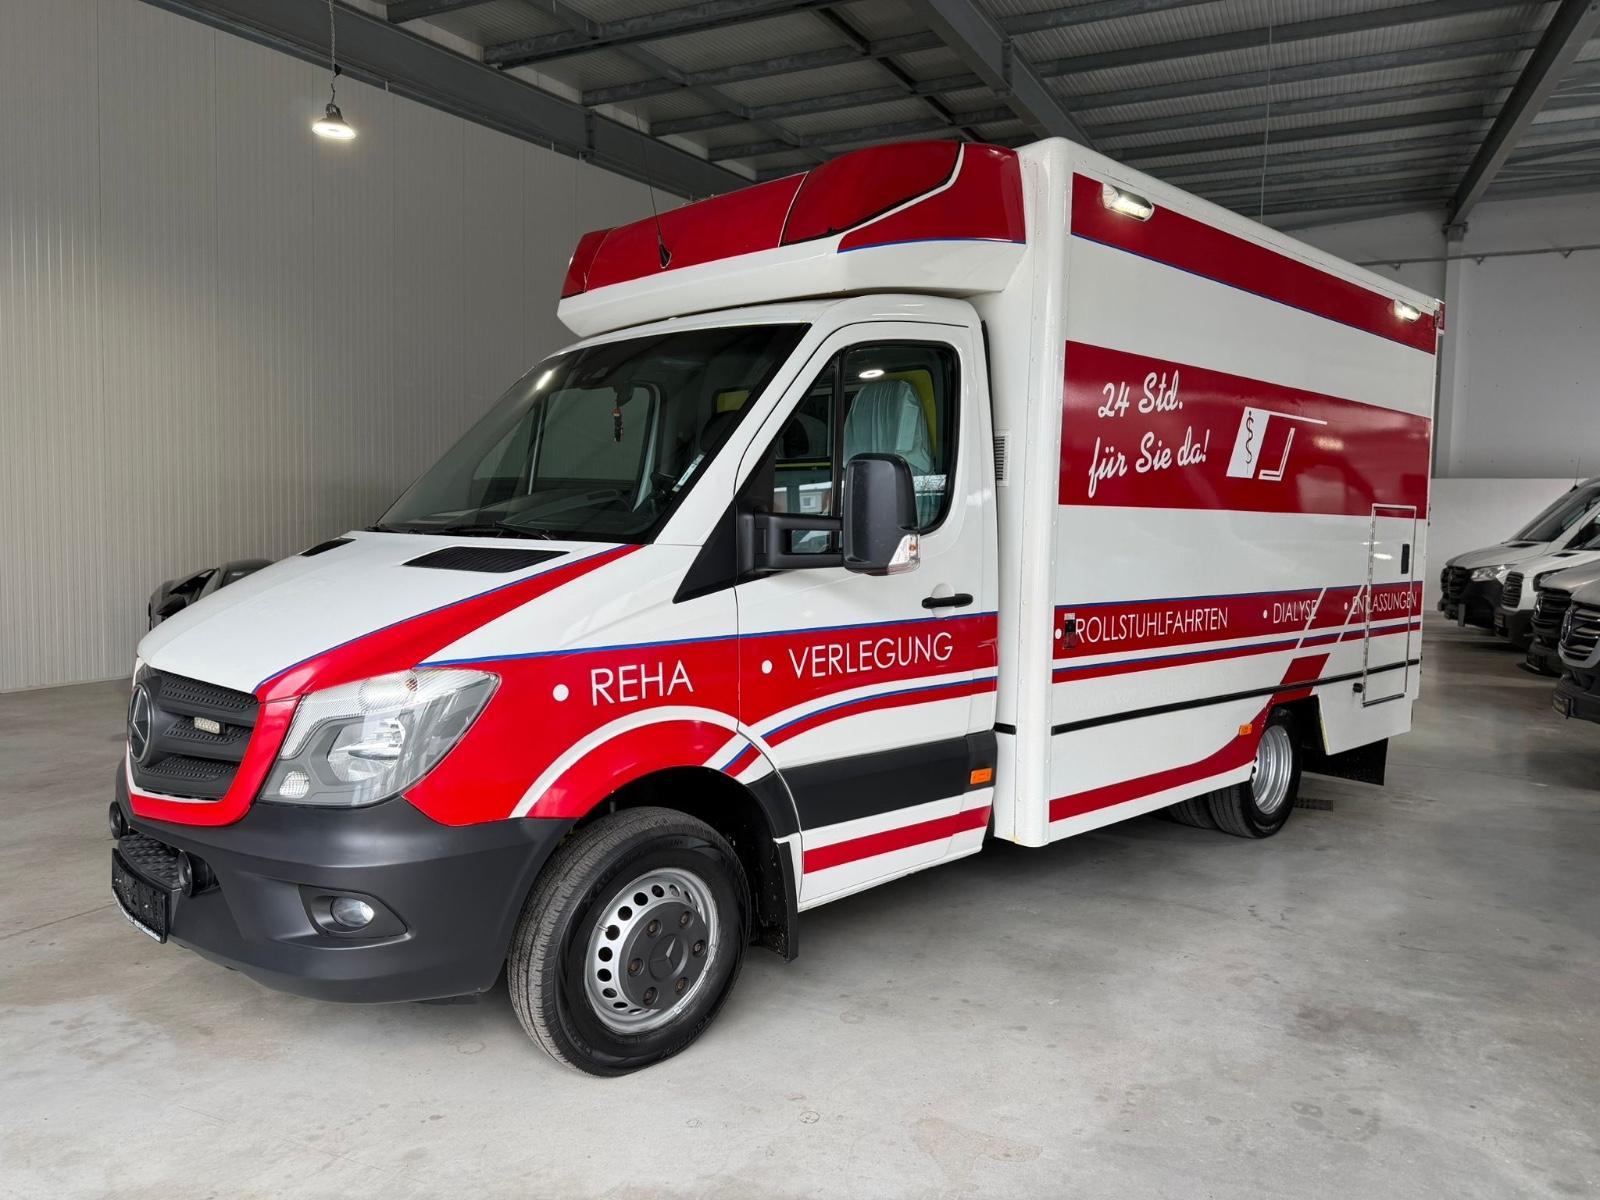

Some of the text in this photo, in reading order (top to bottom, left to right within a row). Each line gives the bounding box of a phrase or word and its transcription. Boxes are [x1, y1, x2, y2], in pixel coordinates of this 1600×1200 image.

[1098, 370, 1184, 417] 24 Std.
[1088, 425, 1210, 498] für Sie da!
[1075, 607, 1229, 644] ROLLSTUHLFAHRTEN
[1272, 599, 1318, 624] DIALYSE
[788, 632, 954, 679] VERLEGUNG
[590, 660, 694, 706] REHA
